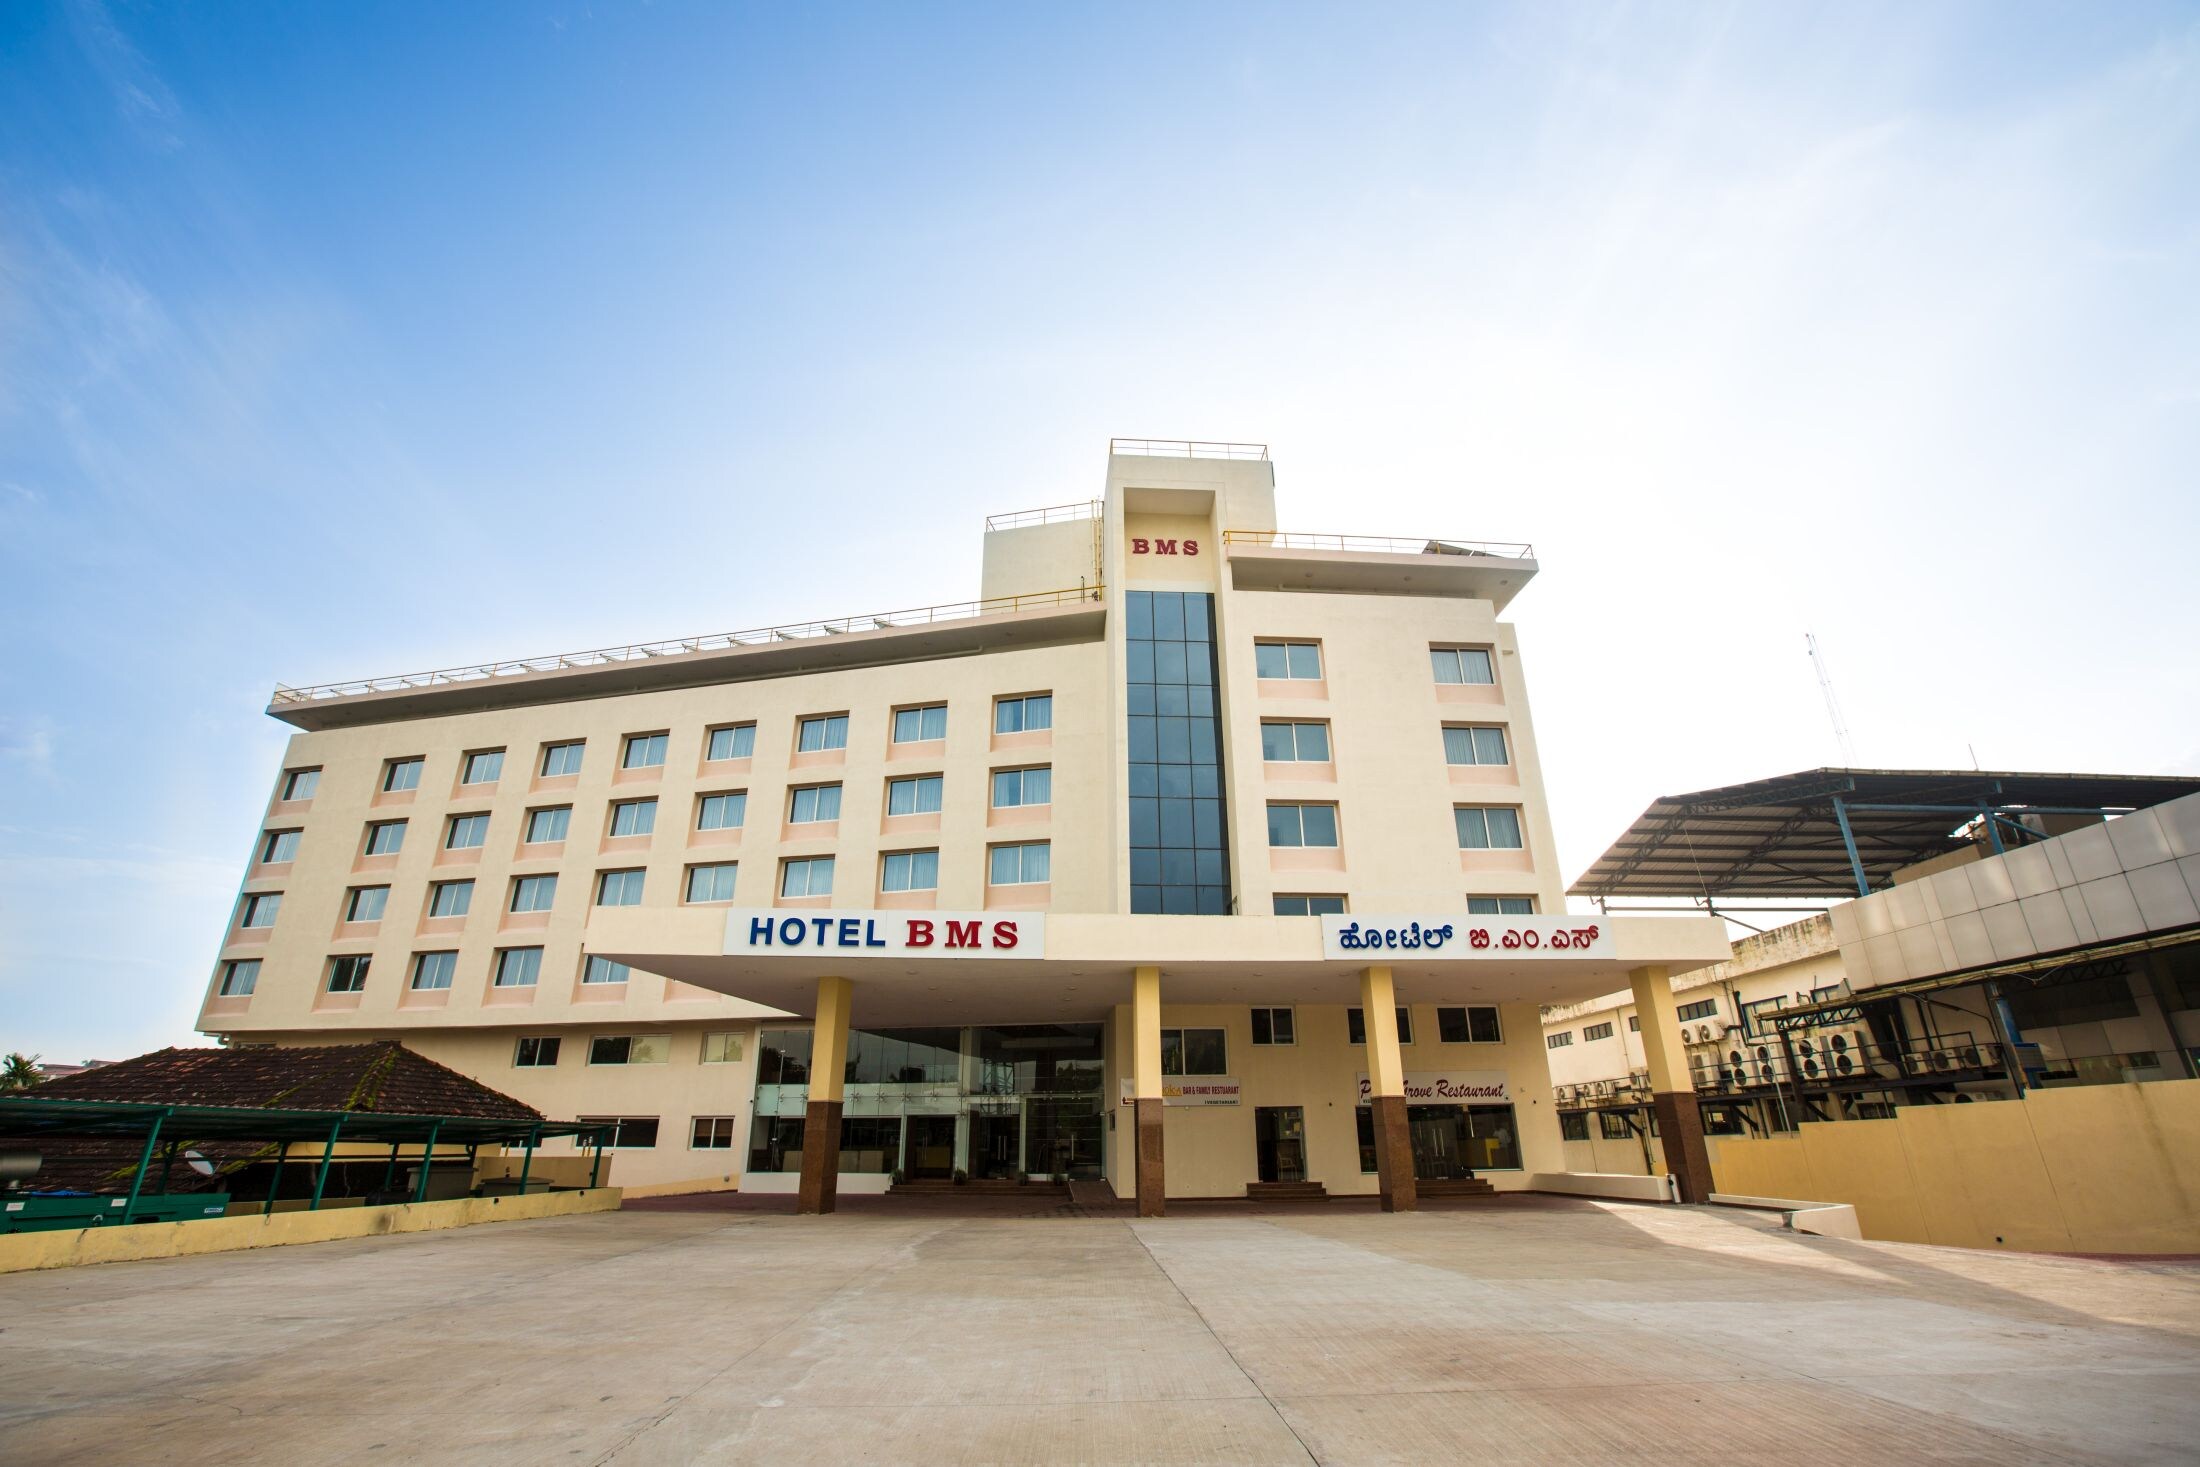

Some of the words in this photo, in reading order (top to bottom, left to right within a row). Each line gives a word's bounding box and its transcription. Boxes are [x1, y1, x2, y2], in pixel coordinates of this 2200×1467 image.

[1132, 538, 1199, 556] BMS
[750, 917, 885, 947] HOTEL
[905, 919, 1018, 948] BMS
[1339, 922, 1453, 950] ಹೋಟೆಲ್
[1183, 1086, 1192, 1095] BAR
[1196, 1086, 1211, 1095] FAMILY
[1436, 1079, 1504, 1098] Restaurant
